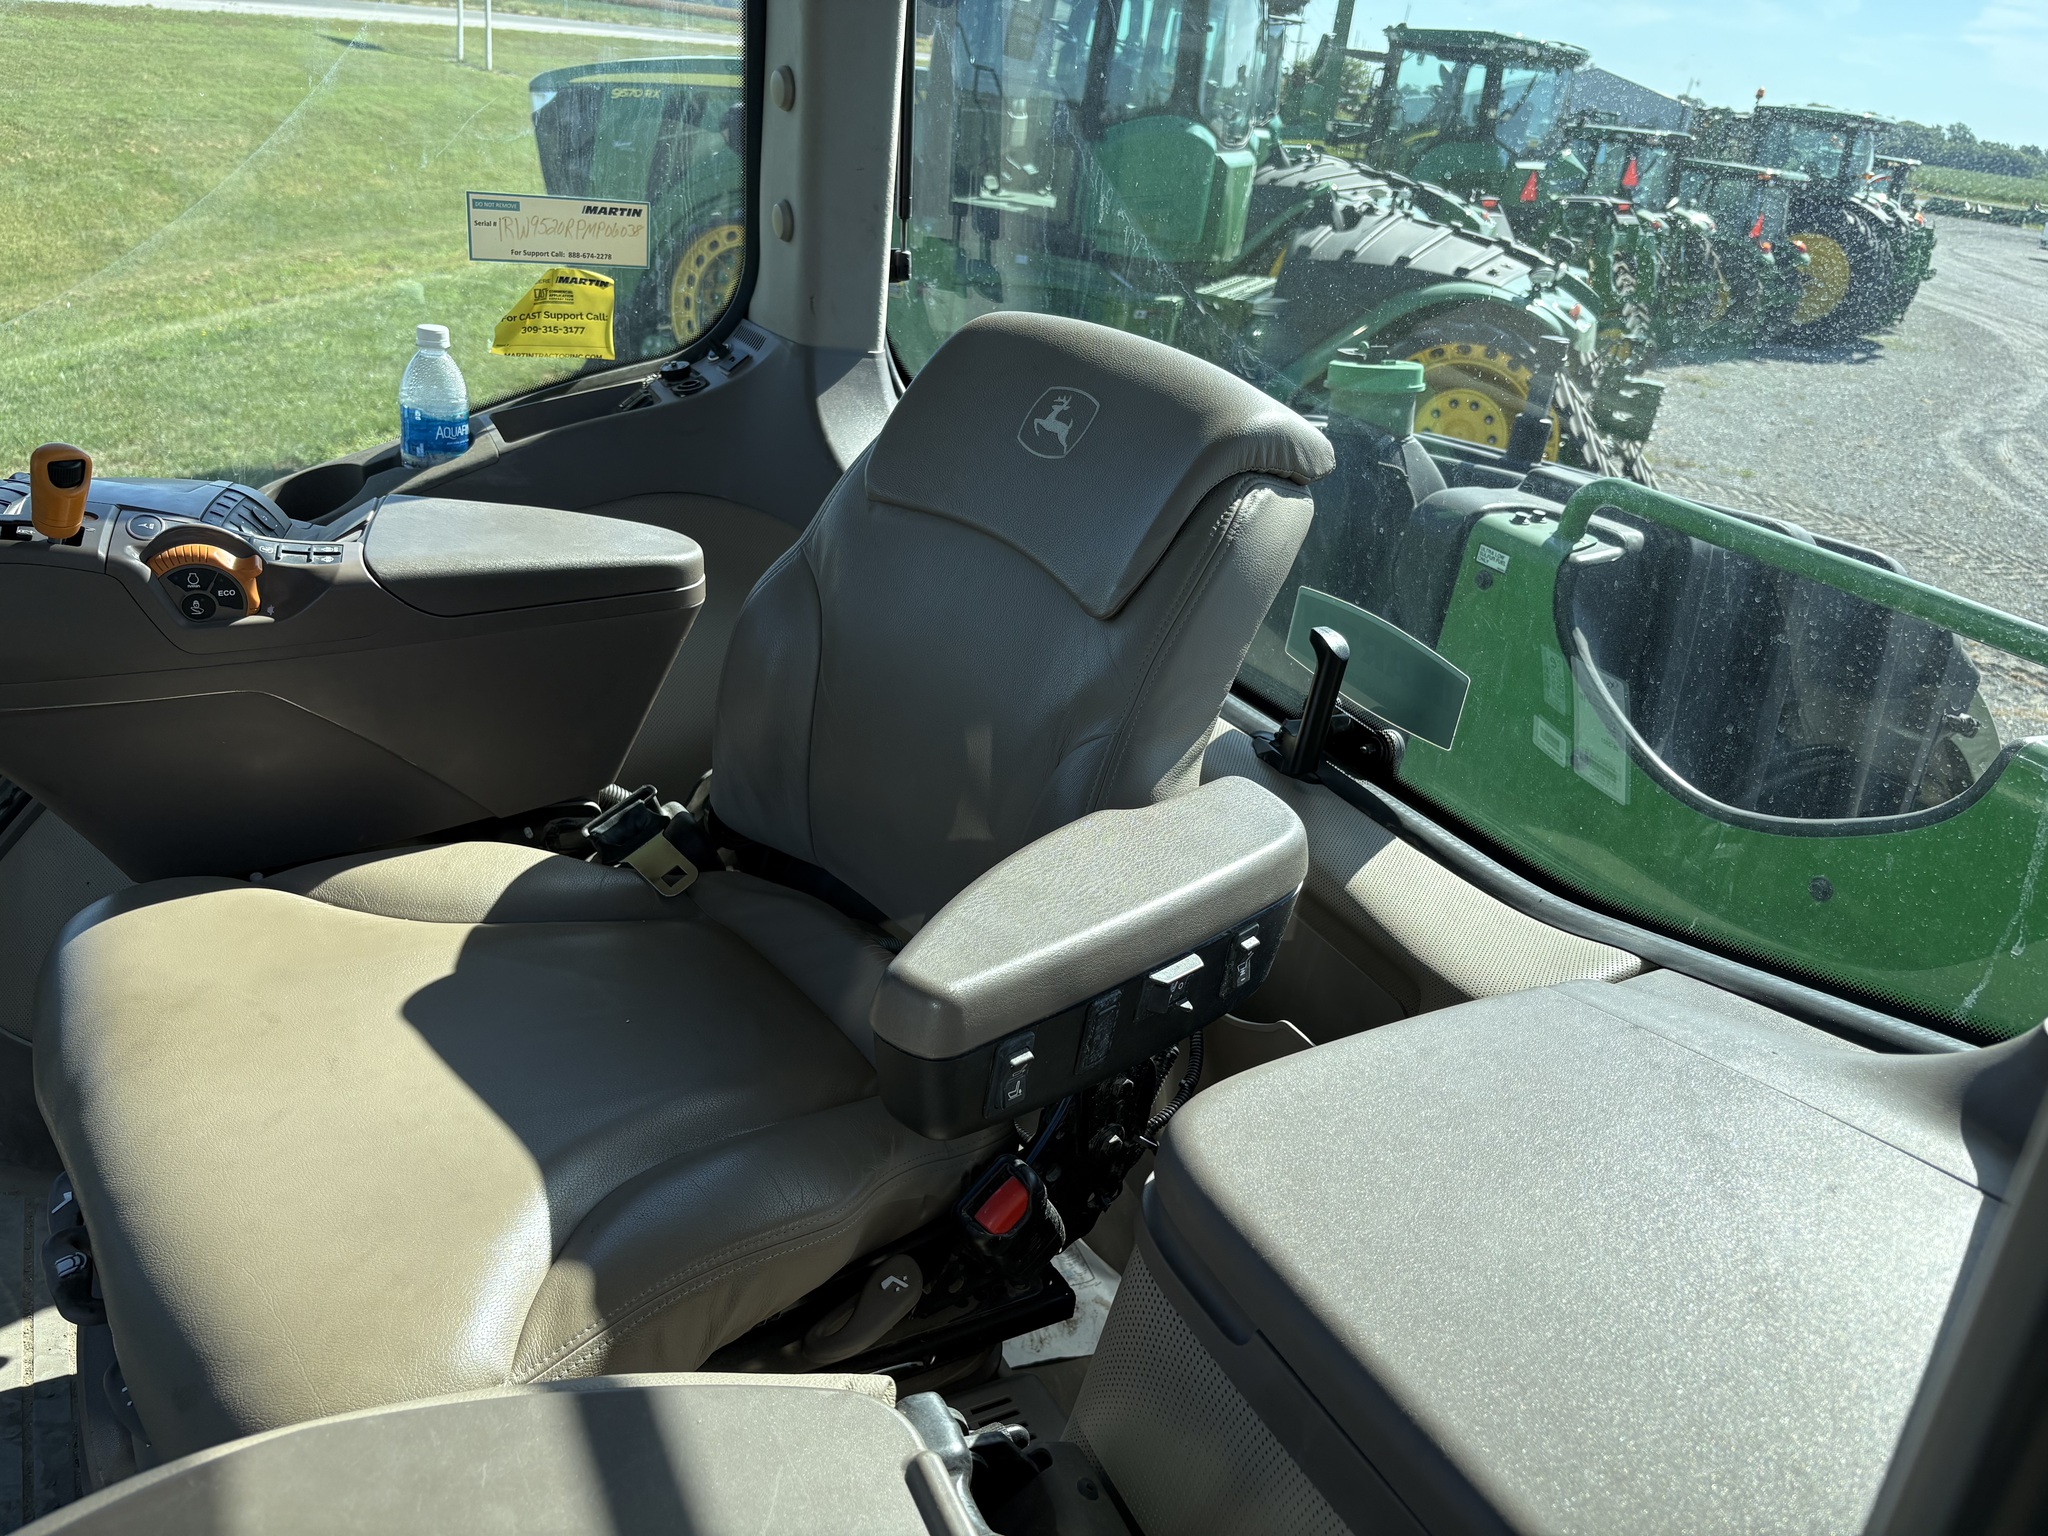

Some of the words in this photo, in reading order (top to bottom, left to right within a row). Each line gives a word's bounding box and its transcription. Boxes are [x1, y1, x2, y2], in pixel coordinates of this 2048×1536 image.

[611, 88, 643, 99] 9570
[523, 250, 549, 258] Support
[568, 252, 612, 260] 888-674-2278
[519, 311, 541, 321] CAST
[543, 311, 584, 321] Support
[586, 313, 608, 321] Call:
[521, 326, 585, 334] 309-315-3177
